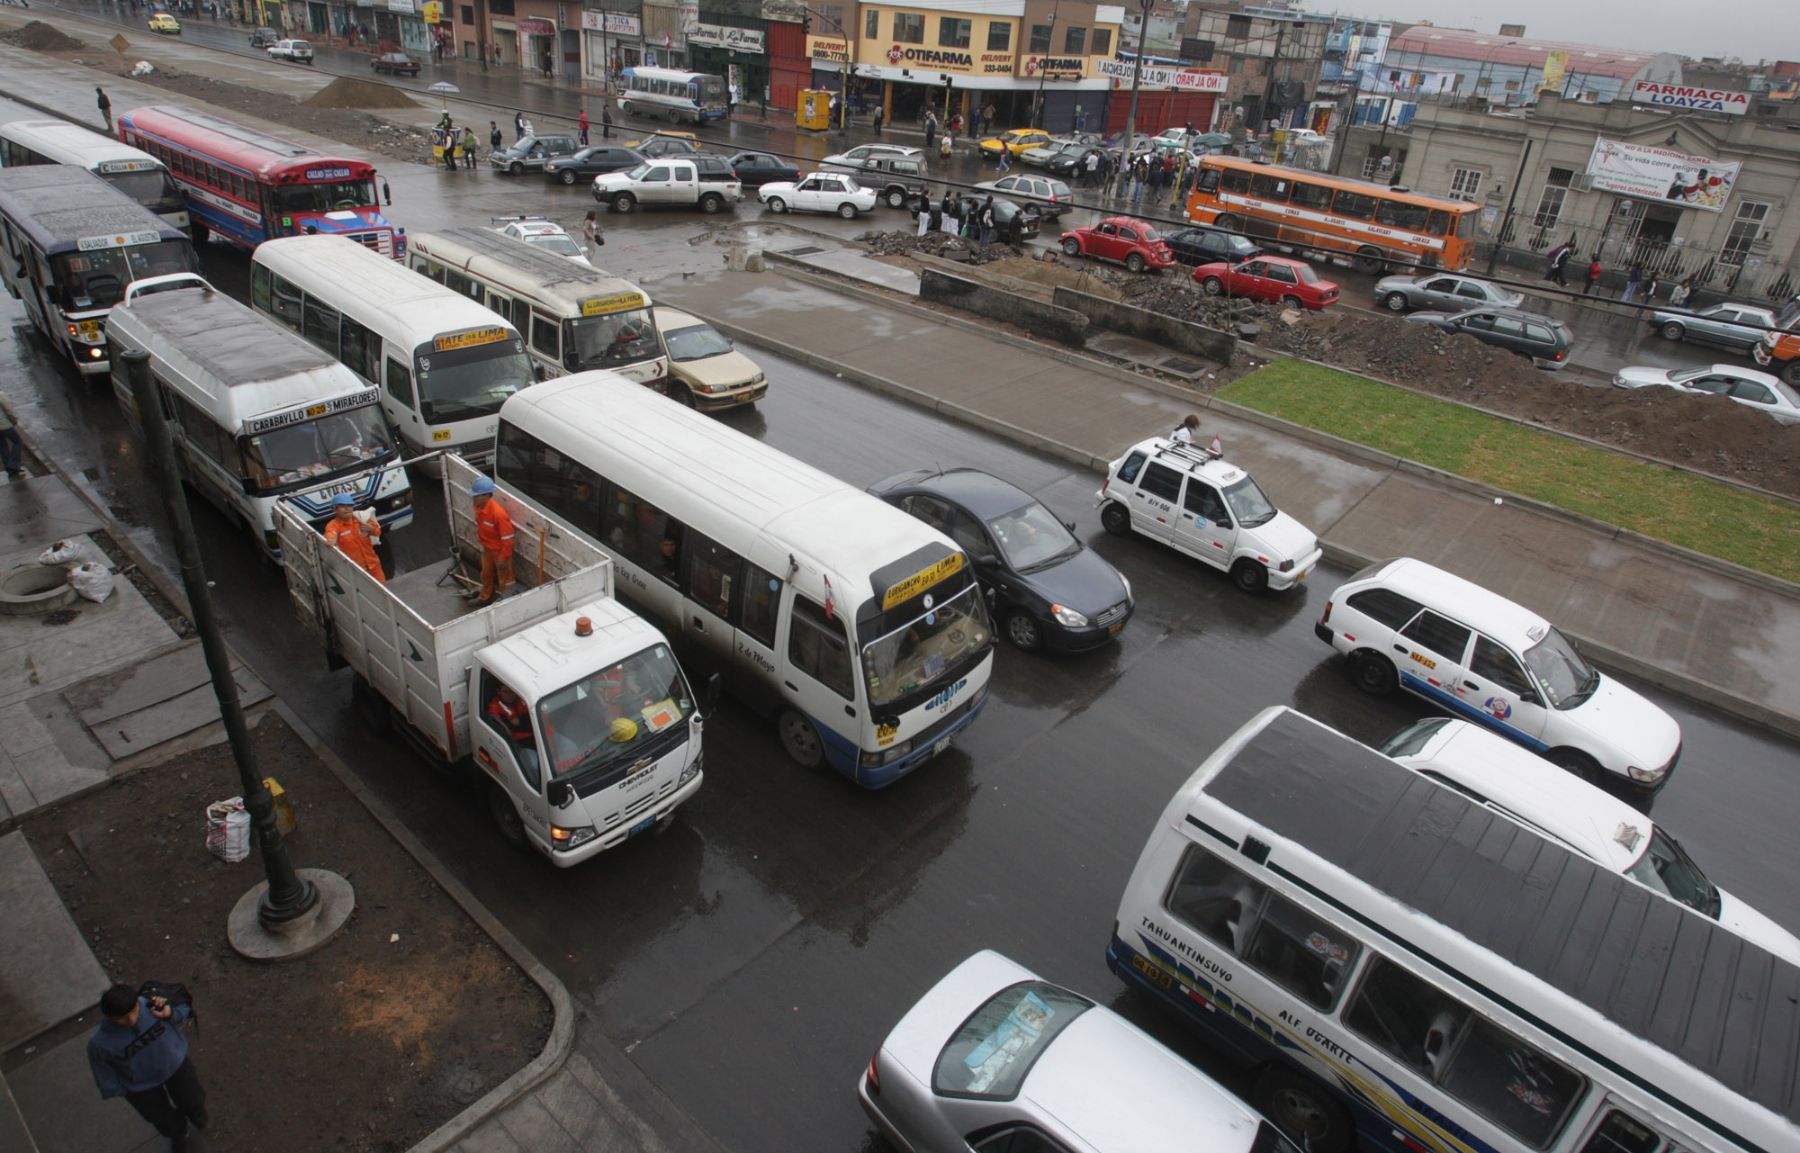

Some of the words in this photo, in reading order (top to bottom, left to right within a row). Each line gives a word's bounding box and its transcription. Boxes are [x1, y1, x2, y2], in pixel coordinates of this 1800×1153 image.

[981, 54, 1012, 63] DELIVERY
[1636, 82, 1747, 104] FARMACIA
[1651, 93, 1724, 111] LOAYZA
[1623, 153, 1634, 161] Su
[1635, 155, 1650, 165] vida
[1651, 159, 1671, 168] corre
[446, 333, 465, 343] ATE
[478, 327, 505, 339] LIMA
[253, 410, 305, 433] CARABAYLLO
[332, 390, 377, 411] MIRAFLORES
[936, 555, 957, 574] LIMA
[752, 650, 776, 673] Mayo
[618, 763, 659, 791] CHEVROLET
[1141, 915, 1233, 983] TAHUANTINSUYO
[1305, 1026, 1354, 1065] UGARTE
